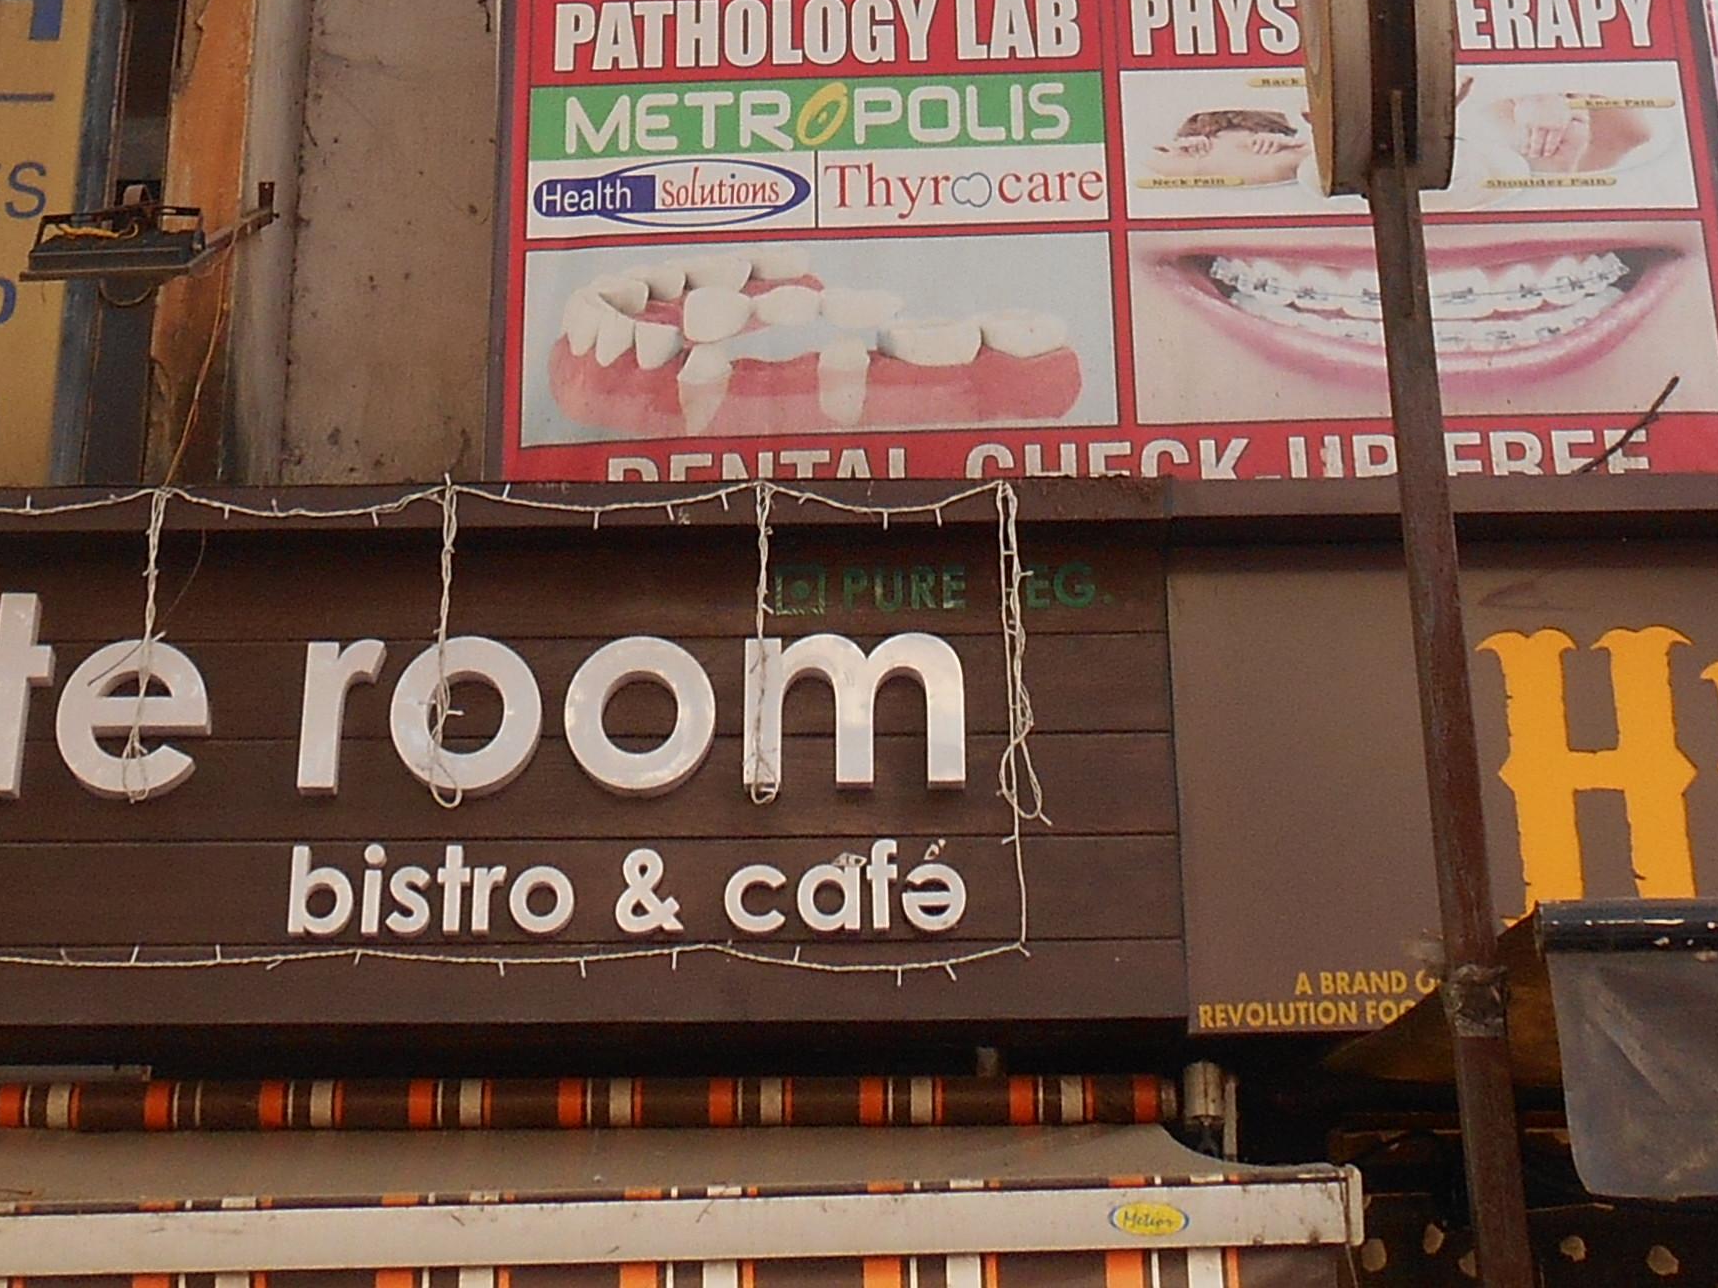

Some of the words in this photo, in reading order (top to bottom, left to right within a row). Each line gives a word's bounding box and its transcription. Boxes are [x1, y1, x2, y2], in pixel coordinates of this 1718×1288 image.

[566, 83, 1071, 152] METROPOLIS
[541, 179, 631, 214] Health
[661, 167, 780, 209] Solutions
[843, 565, 967, 613] PURE
[296, 632, 969, 798] room
[286, 844, 576, 939] bistro
[615, 849, 683, 935] &
[1295, 972, 1313, 995] A
[1320, 971, 1408, 995] BRAND
[1199, 1000, 1358, 1029] REVOLUTION
